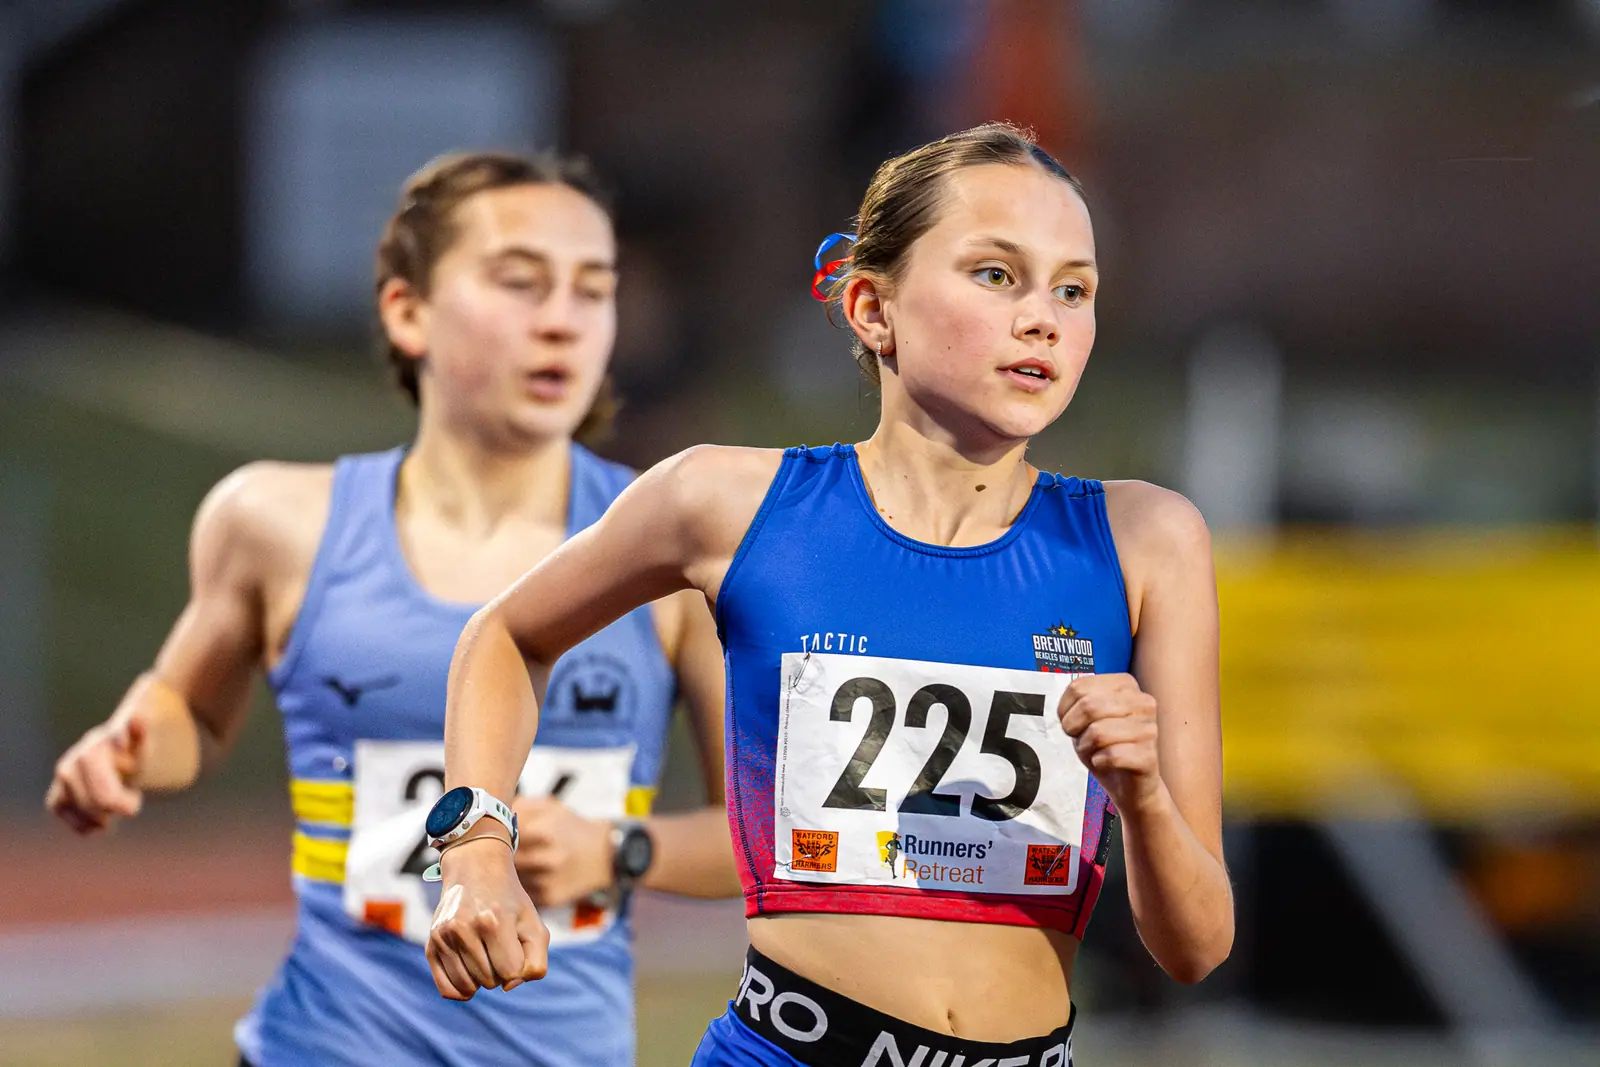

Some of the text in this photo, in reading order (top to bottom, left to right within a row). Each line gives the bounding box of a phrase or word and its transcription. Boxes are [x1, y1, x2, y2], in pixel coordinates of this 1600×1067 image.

[800, 632, 868, 653] TACTIC
[1032, 635, 1093, 656] BRENTWOOD
[1035, 651, 1058, 661] BEAGLES
[821, 677, 1046, 822] 225
[795, 832, 834, 840] WATFORD
[903, 859, 985, 884] Retreat
[738, 958, 828, 1043] RO
